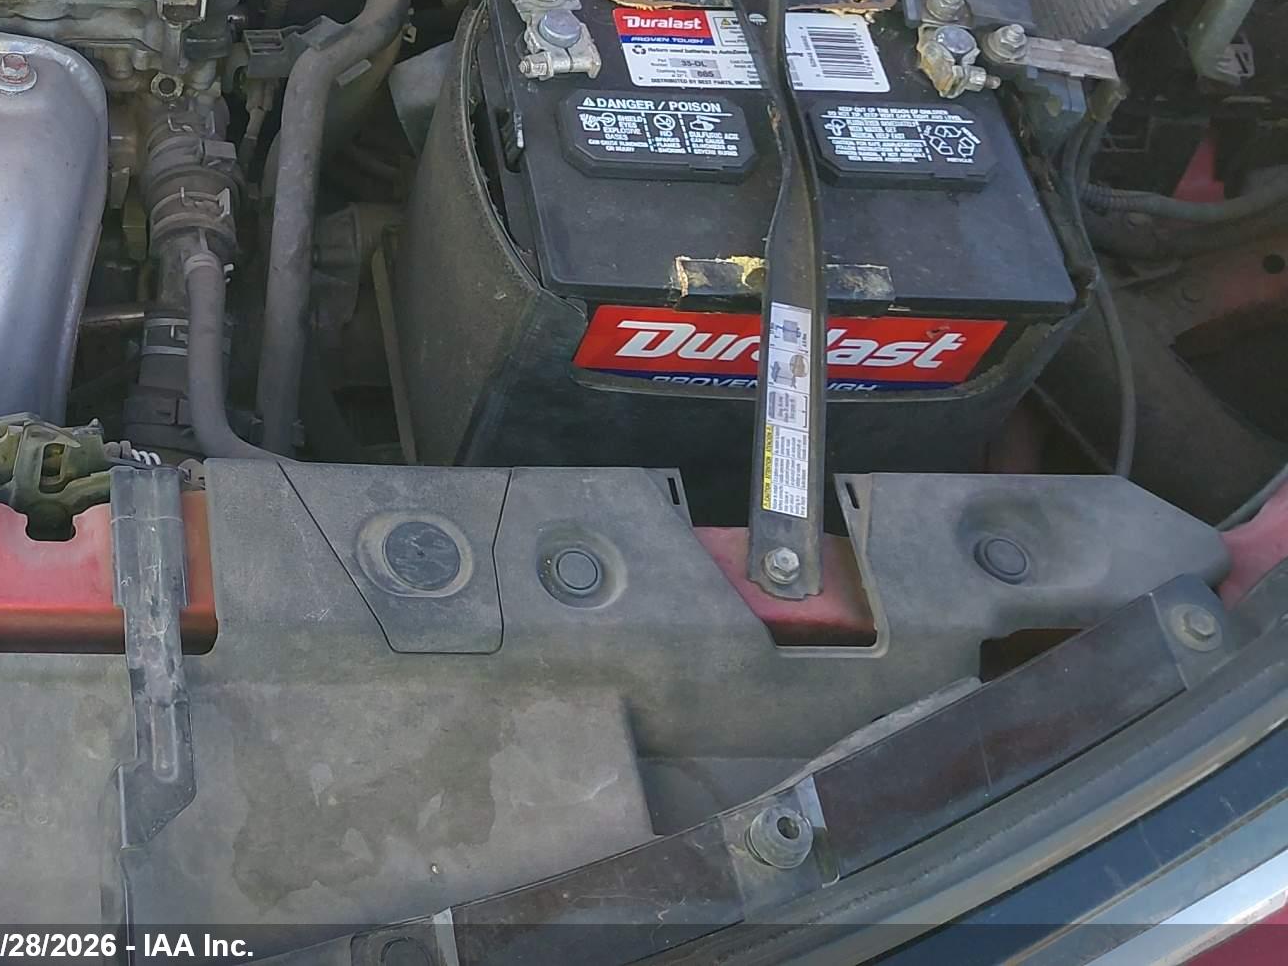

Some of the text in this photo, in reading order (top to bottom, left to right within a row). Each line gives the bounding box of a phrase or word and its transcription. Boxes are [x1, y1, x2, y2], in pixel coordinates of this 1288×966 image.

[622, 16, 703, 30] Duralast
[596, 98, 722, 113] DANGER / POISON
[617, 115, 643, 123] SHIELD
[603, 127, 642, 135] EXPLOSIVE
[689, 131, 723, 139] SULFURIC
[615, 320, 965, 369] Durast
